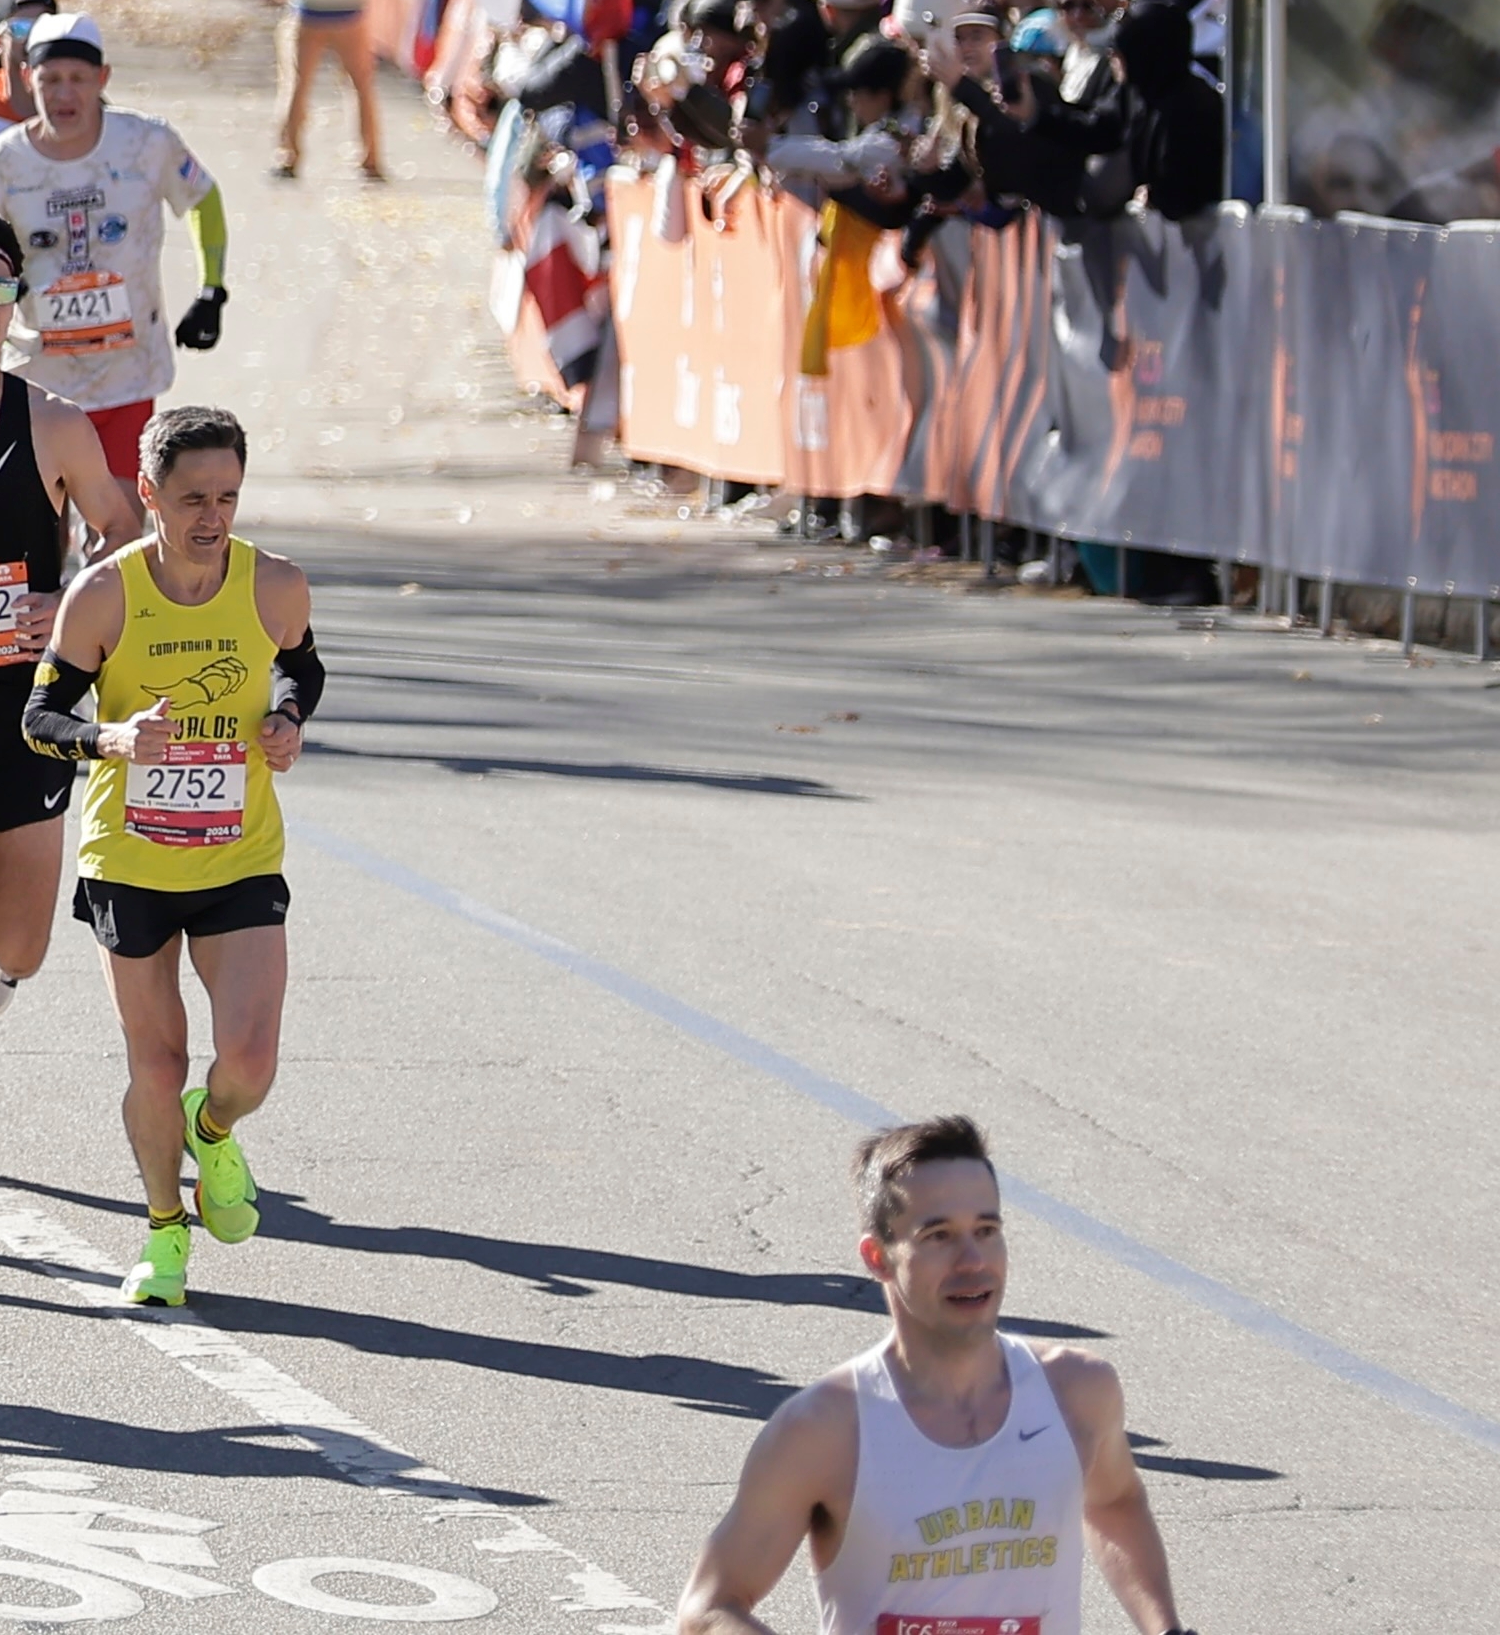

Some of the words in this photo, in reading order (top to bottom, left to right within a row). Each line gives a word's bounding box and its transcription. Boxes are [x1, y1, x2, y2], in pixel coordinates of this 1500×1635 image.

[50, 291, 112, 322] 2421
[149, 639, 213, 657] COMPANHIA
[218, 639, 238, 652] DOS
[146, 768, 226, 799] 2752
[206, 826, 230, 836] 2024
[915, 1497, 1036, 1546] URBAN
[888, 1535, 1059, 1583] ATHLETICS
